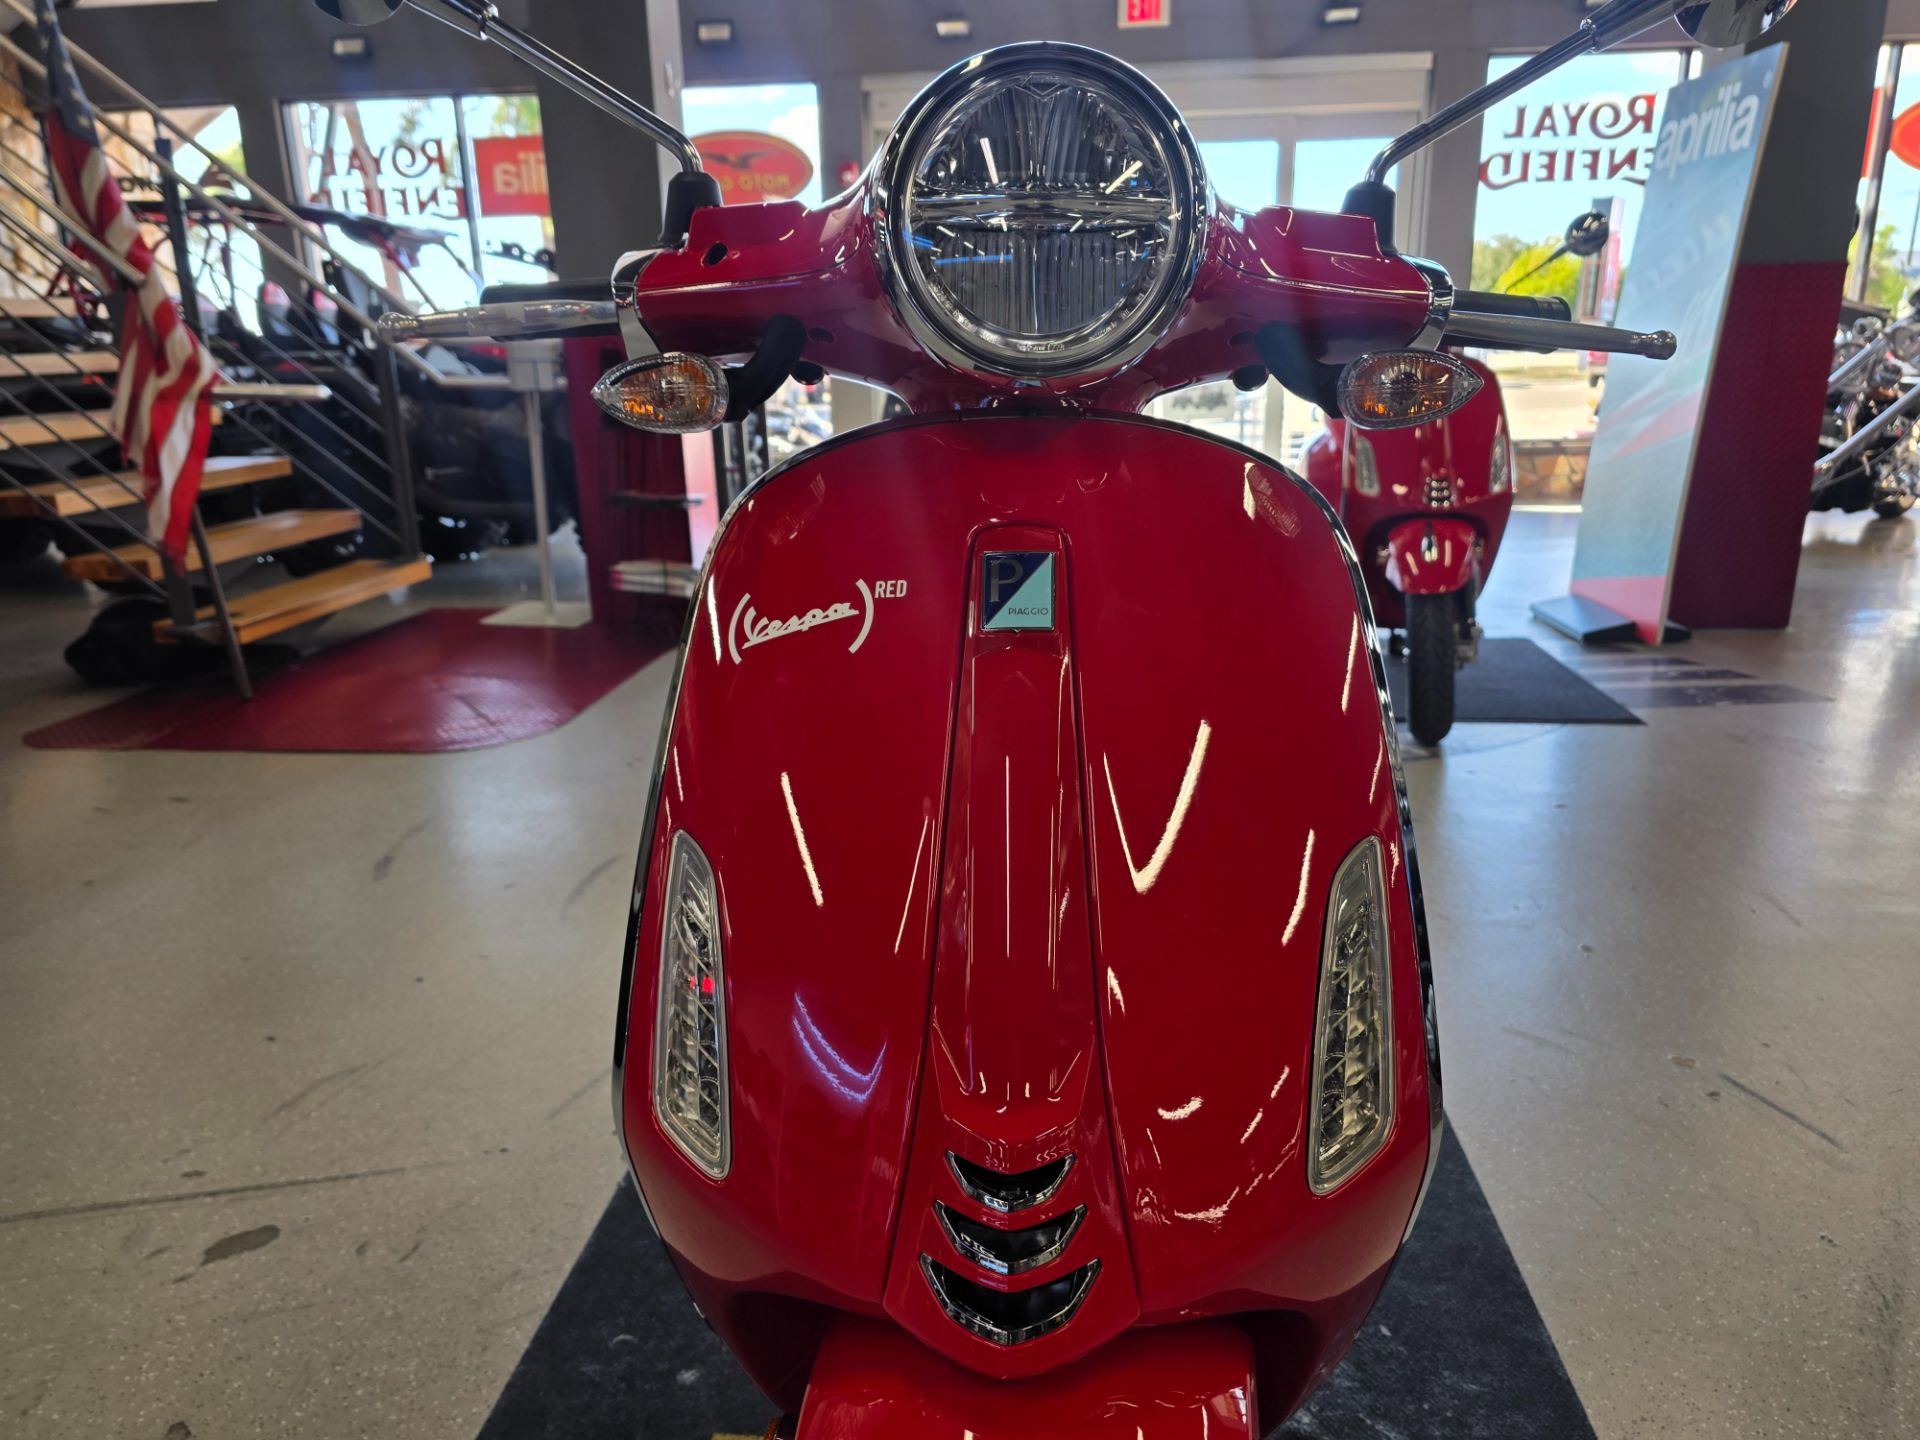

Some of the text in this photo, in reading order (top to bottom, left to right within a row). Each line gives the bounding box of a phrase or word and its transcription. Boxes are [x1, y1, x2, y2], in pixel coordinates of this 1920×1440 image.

[1653, 79, 1760, 181] aprilia
[874, 579, 908, 599] RED
[990, 558, 1023, 602] P
[1008, 607, 1049, 616] PIAGGIO
